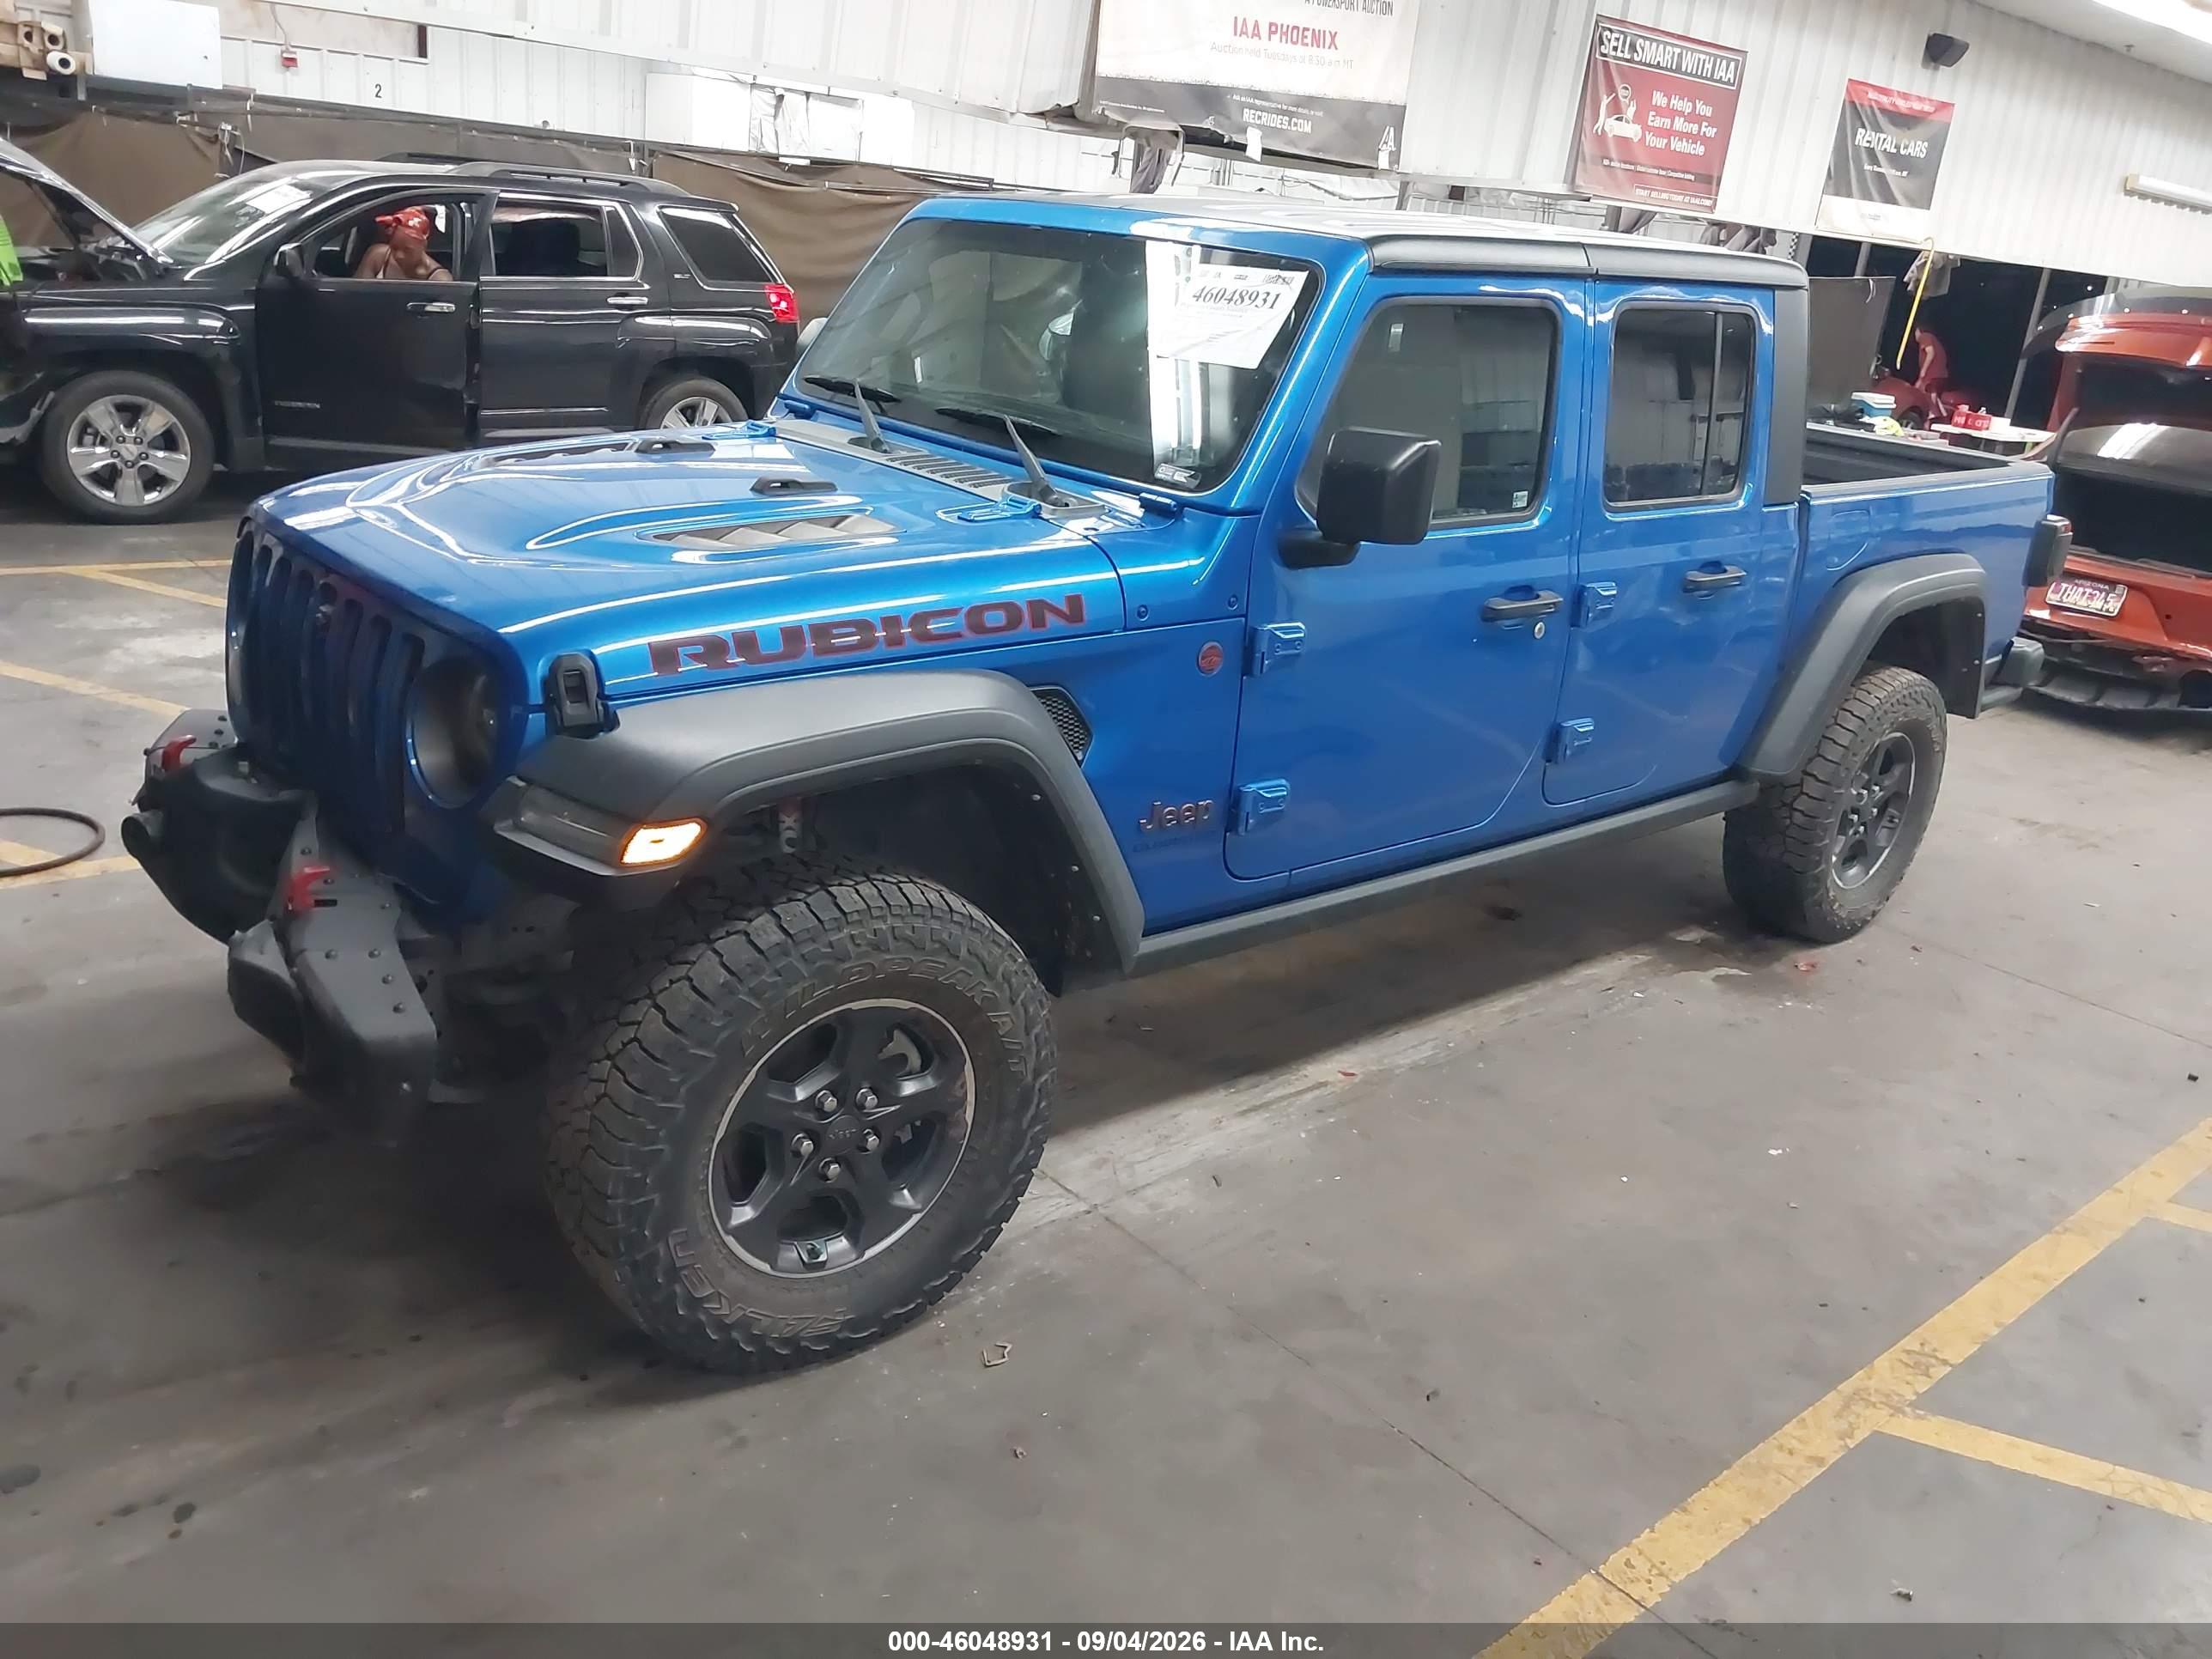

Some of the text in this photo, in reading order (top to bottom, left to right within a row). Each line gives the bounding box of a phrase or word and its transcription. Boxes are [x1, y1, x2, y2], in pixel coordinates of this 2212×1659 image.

[1362, 0, 1394, 16] AUCTION
[1233, 15, 1339, 50] IAA PHOENIX
[1600, 30, 1735, 83] SELL SMART WITH IAA
[374, 83, 382, 99] 2
[1651, 89, 1668, 108] We
[1669, 94, 1693, 114] Help
[1694, 99, 1712, 118] You
[1243, 107, 1312, 133] RECRIDES.COM
[1647, 111, 1717, 139] Earn More For
[1644, 131, 1705, 156] Your Vehicle
[1855, 127, 1929, 159] RENTAL CARS
[1192, 285, 1282, 310] 46048931
[647, 593, 1085, 677] RUBICON
[1139, 799, 1214, 832] Jeep
